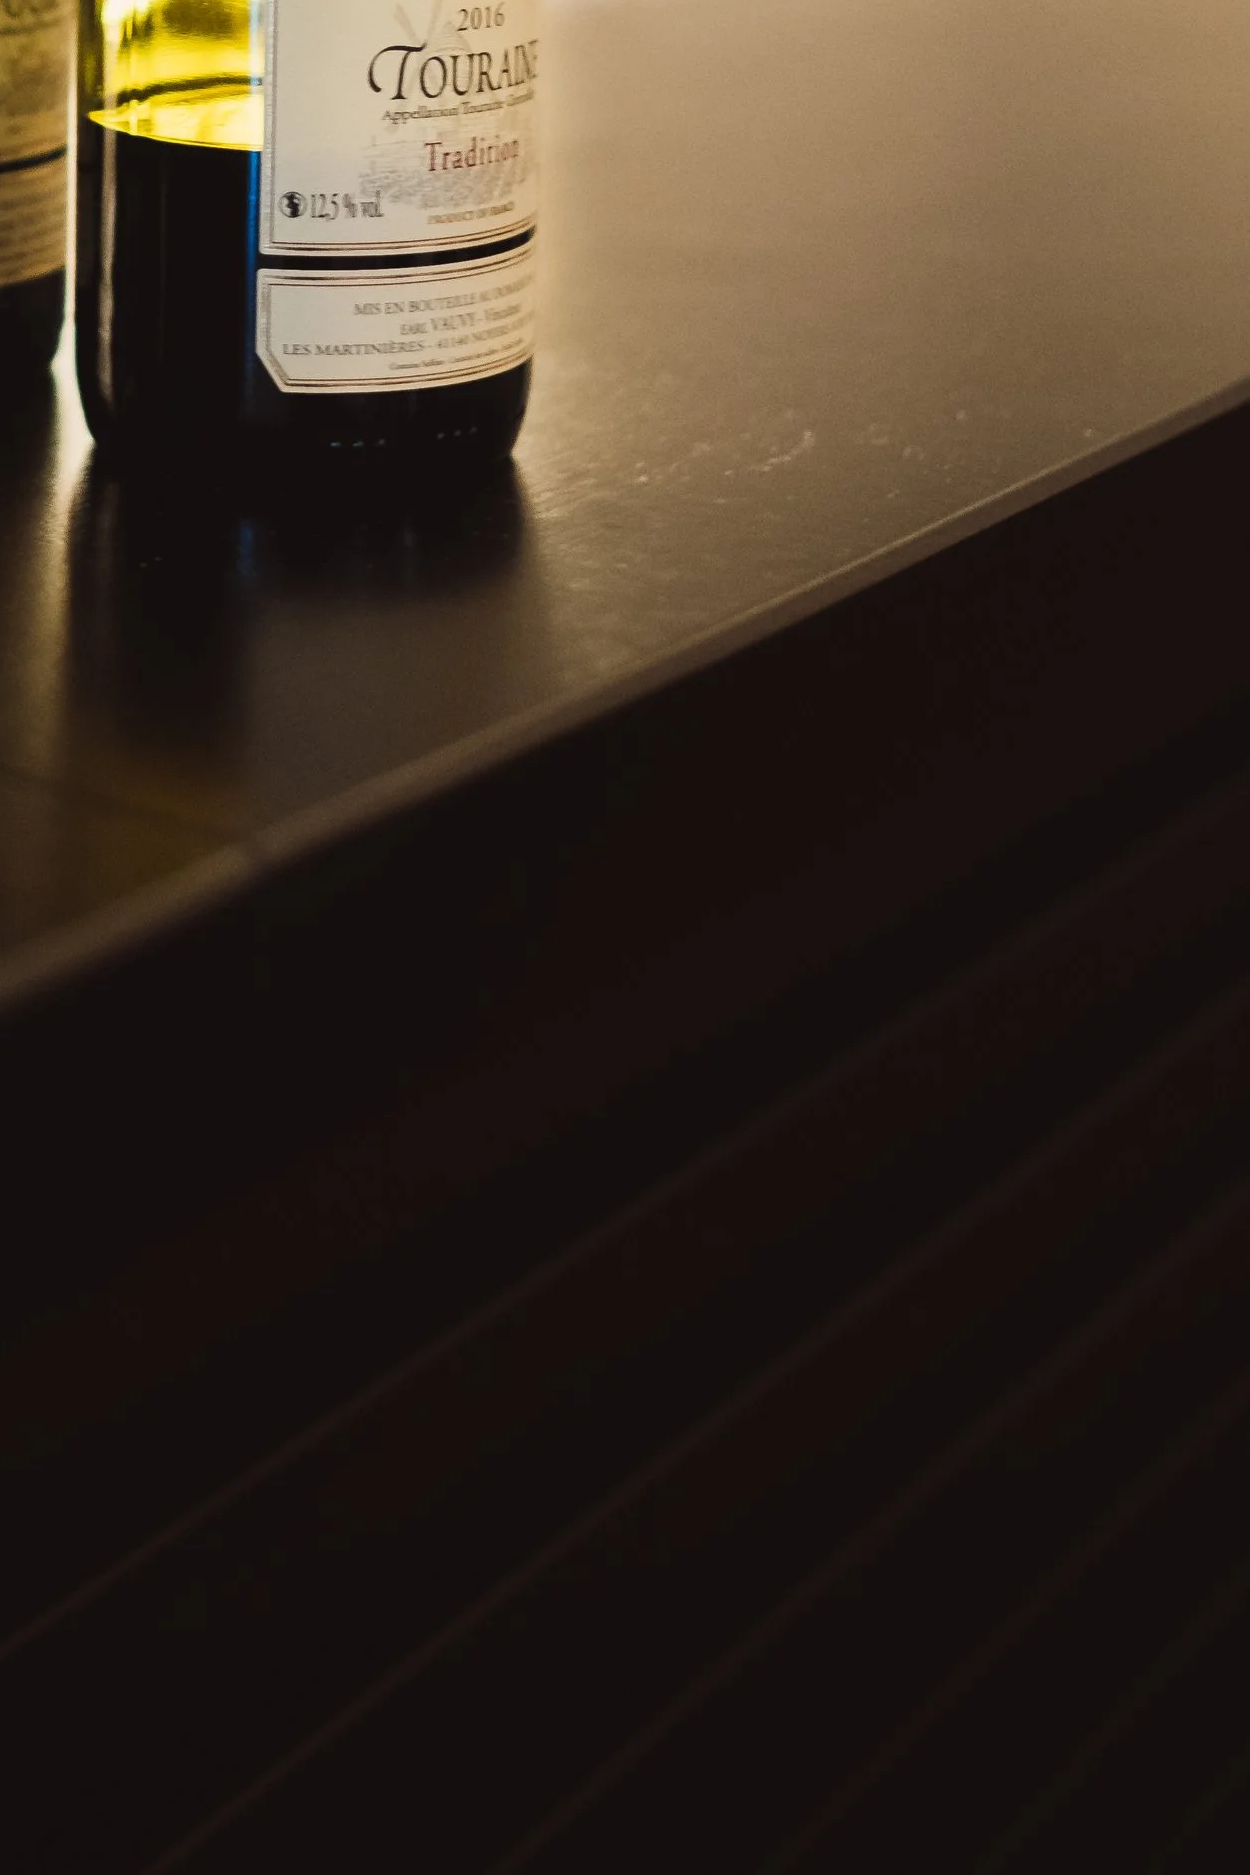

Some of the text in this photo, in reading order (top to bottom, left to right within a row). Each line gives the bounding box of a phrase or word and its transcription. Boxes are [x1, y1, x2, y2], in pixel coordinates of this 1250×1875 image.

[457, 2, 505, 32] 2016
[424, 134, 520, 172] Tradition
[353, 302, 382, 316] MIS
[385, 301, 405, 315] EN
[282, 343, 310, 356] LES
[314, 339, 425, 356] MARTINIÈRES
